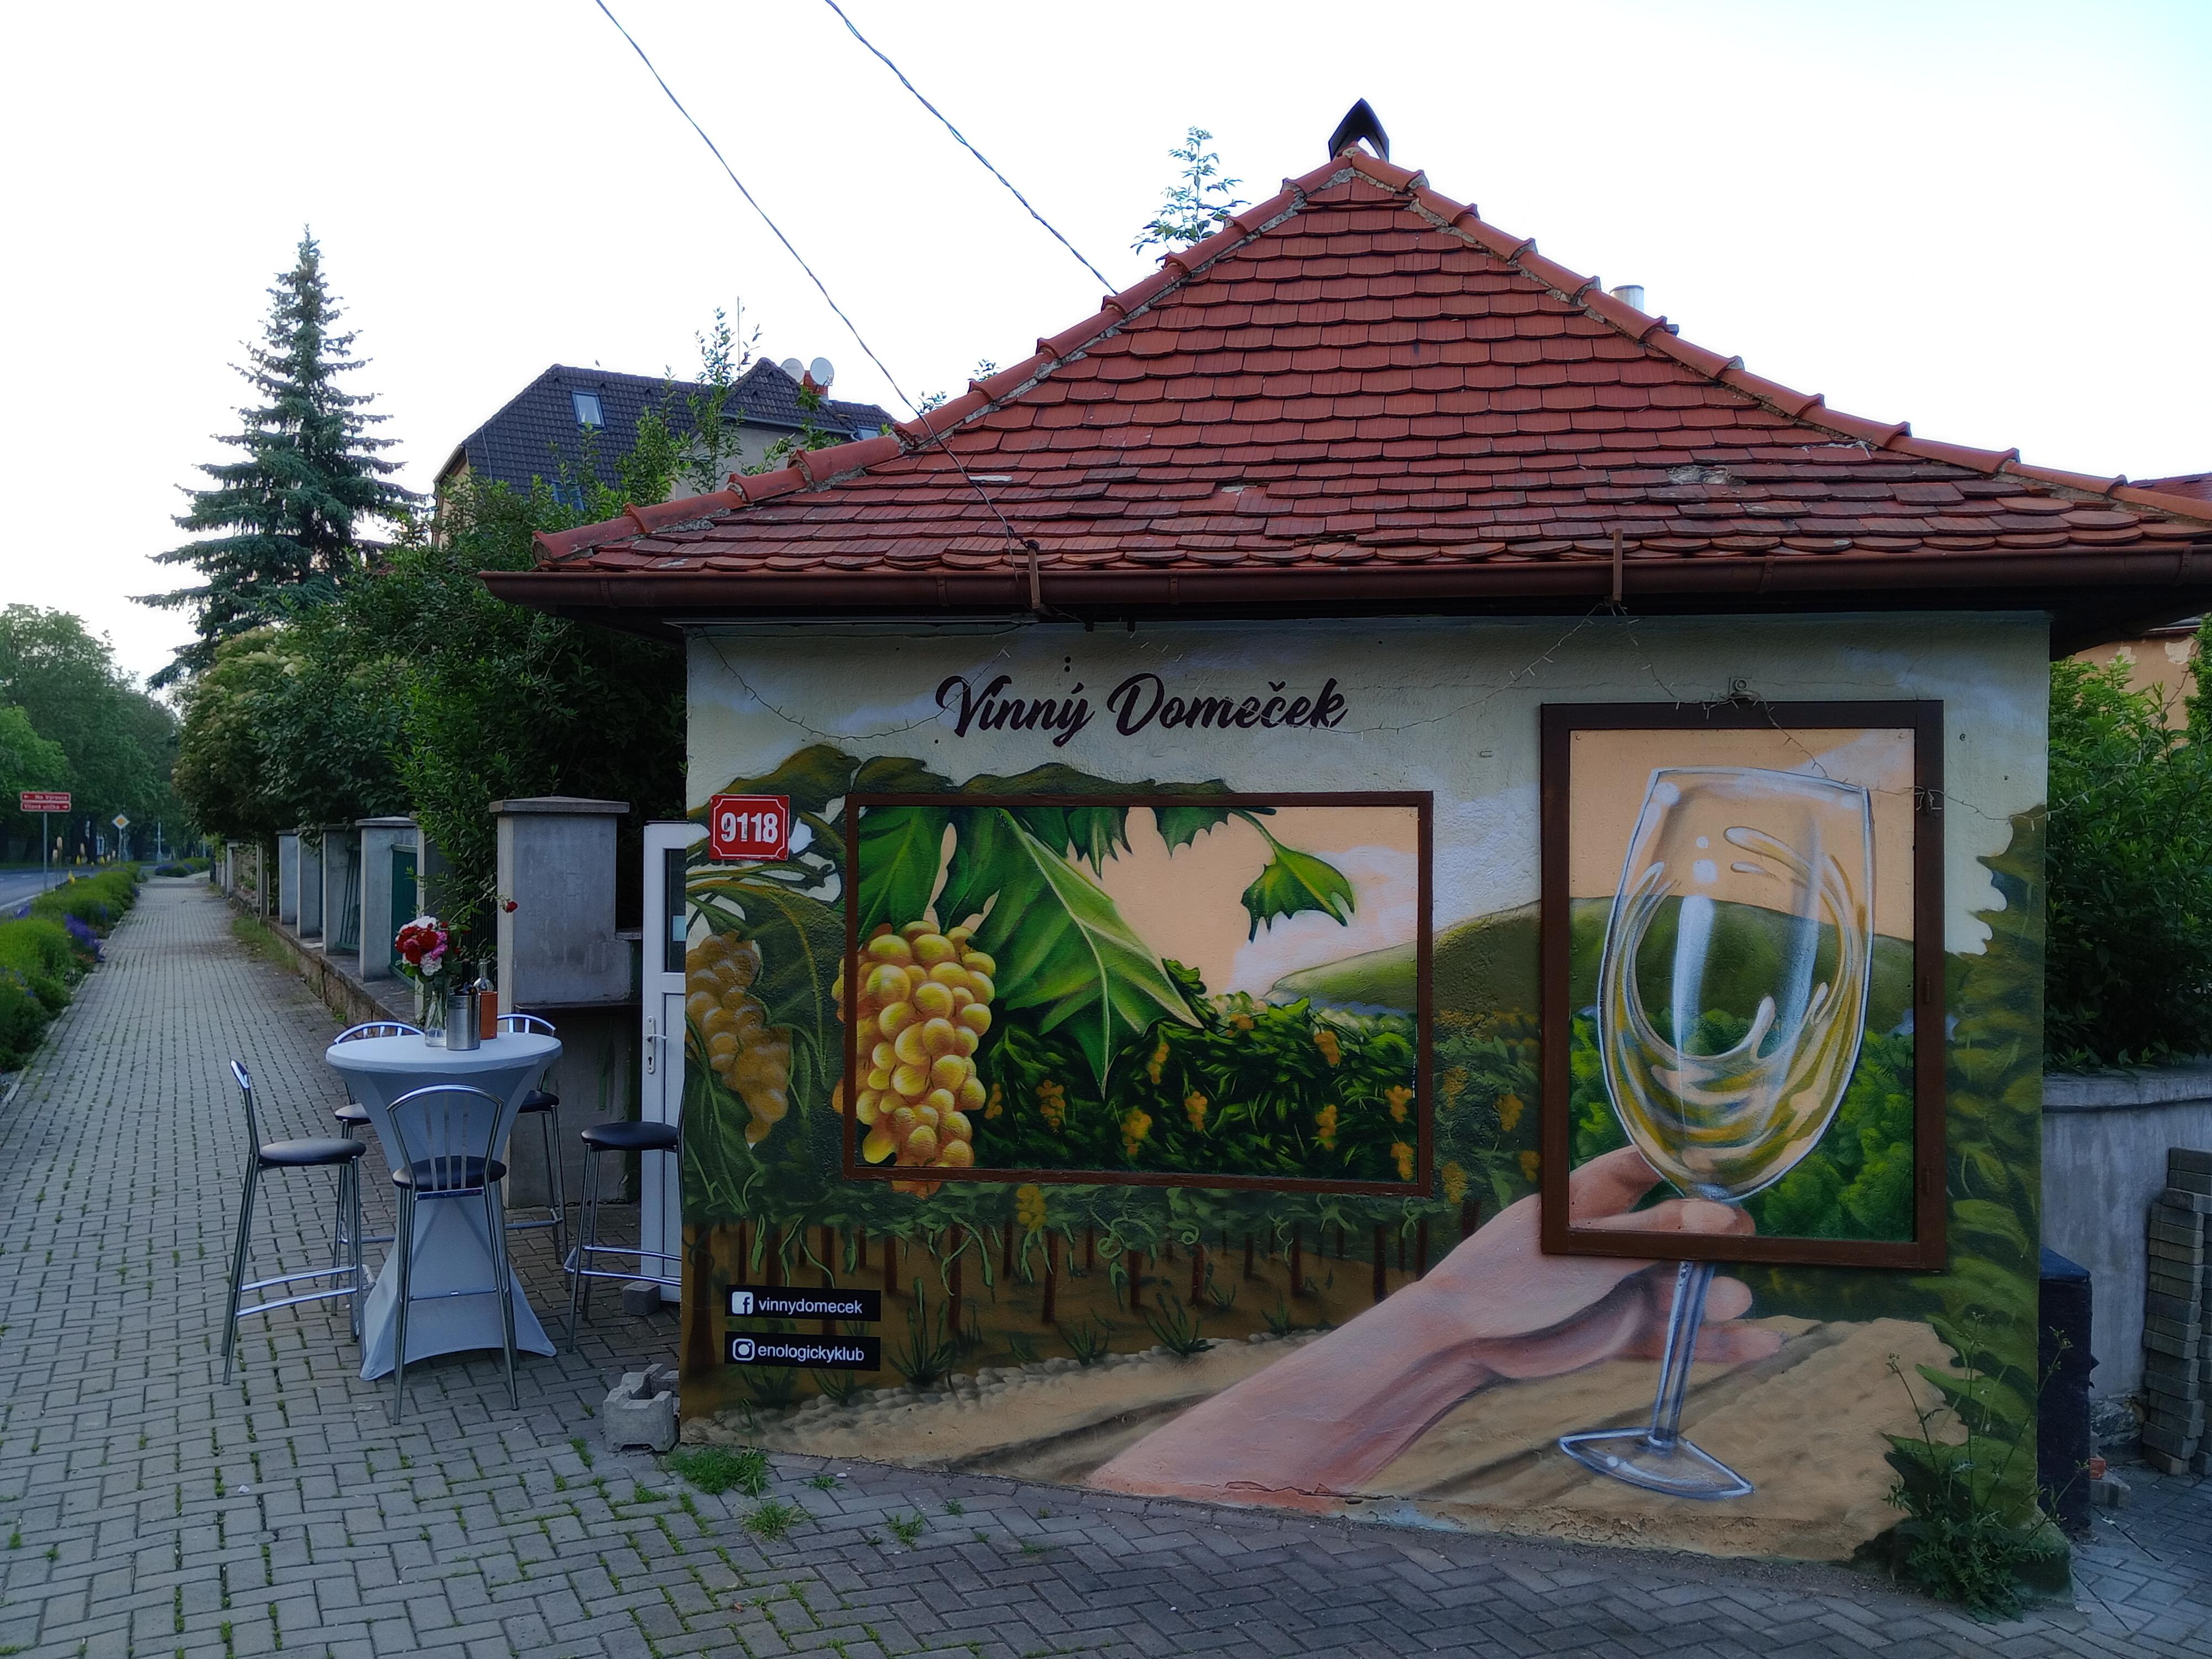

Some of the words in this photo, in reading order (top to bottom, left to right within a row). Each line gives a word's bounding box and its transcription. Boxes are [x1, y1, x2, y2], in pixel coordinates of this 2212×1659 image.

[935, 675, 1095, 748] Vinný
[1107, 672, 1349, 736] Domeček
[721, 812, 778, 844] 9118
[758, 1296, 863, 1316] vinnydomecek
[757, 1343, 865, 1364] enologickyklub
